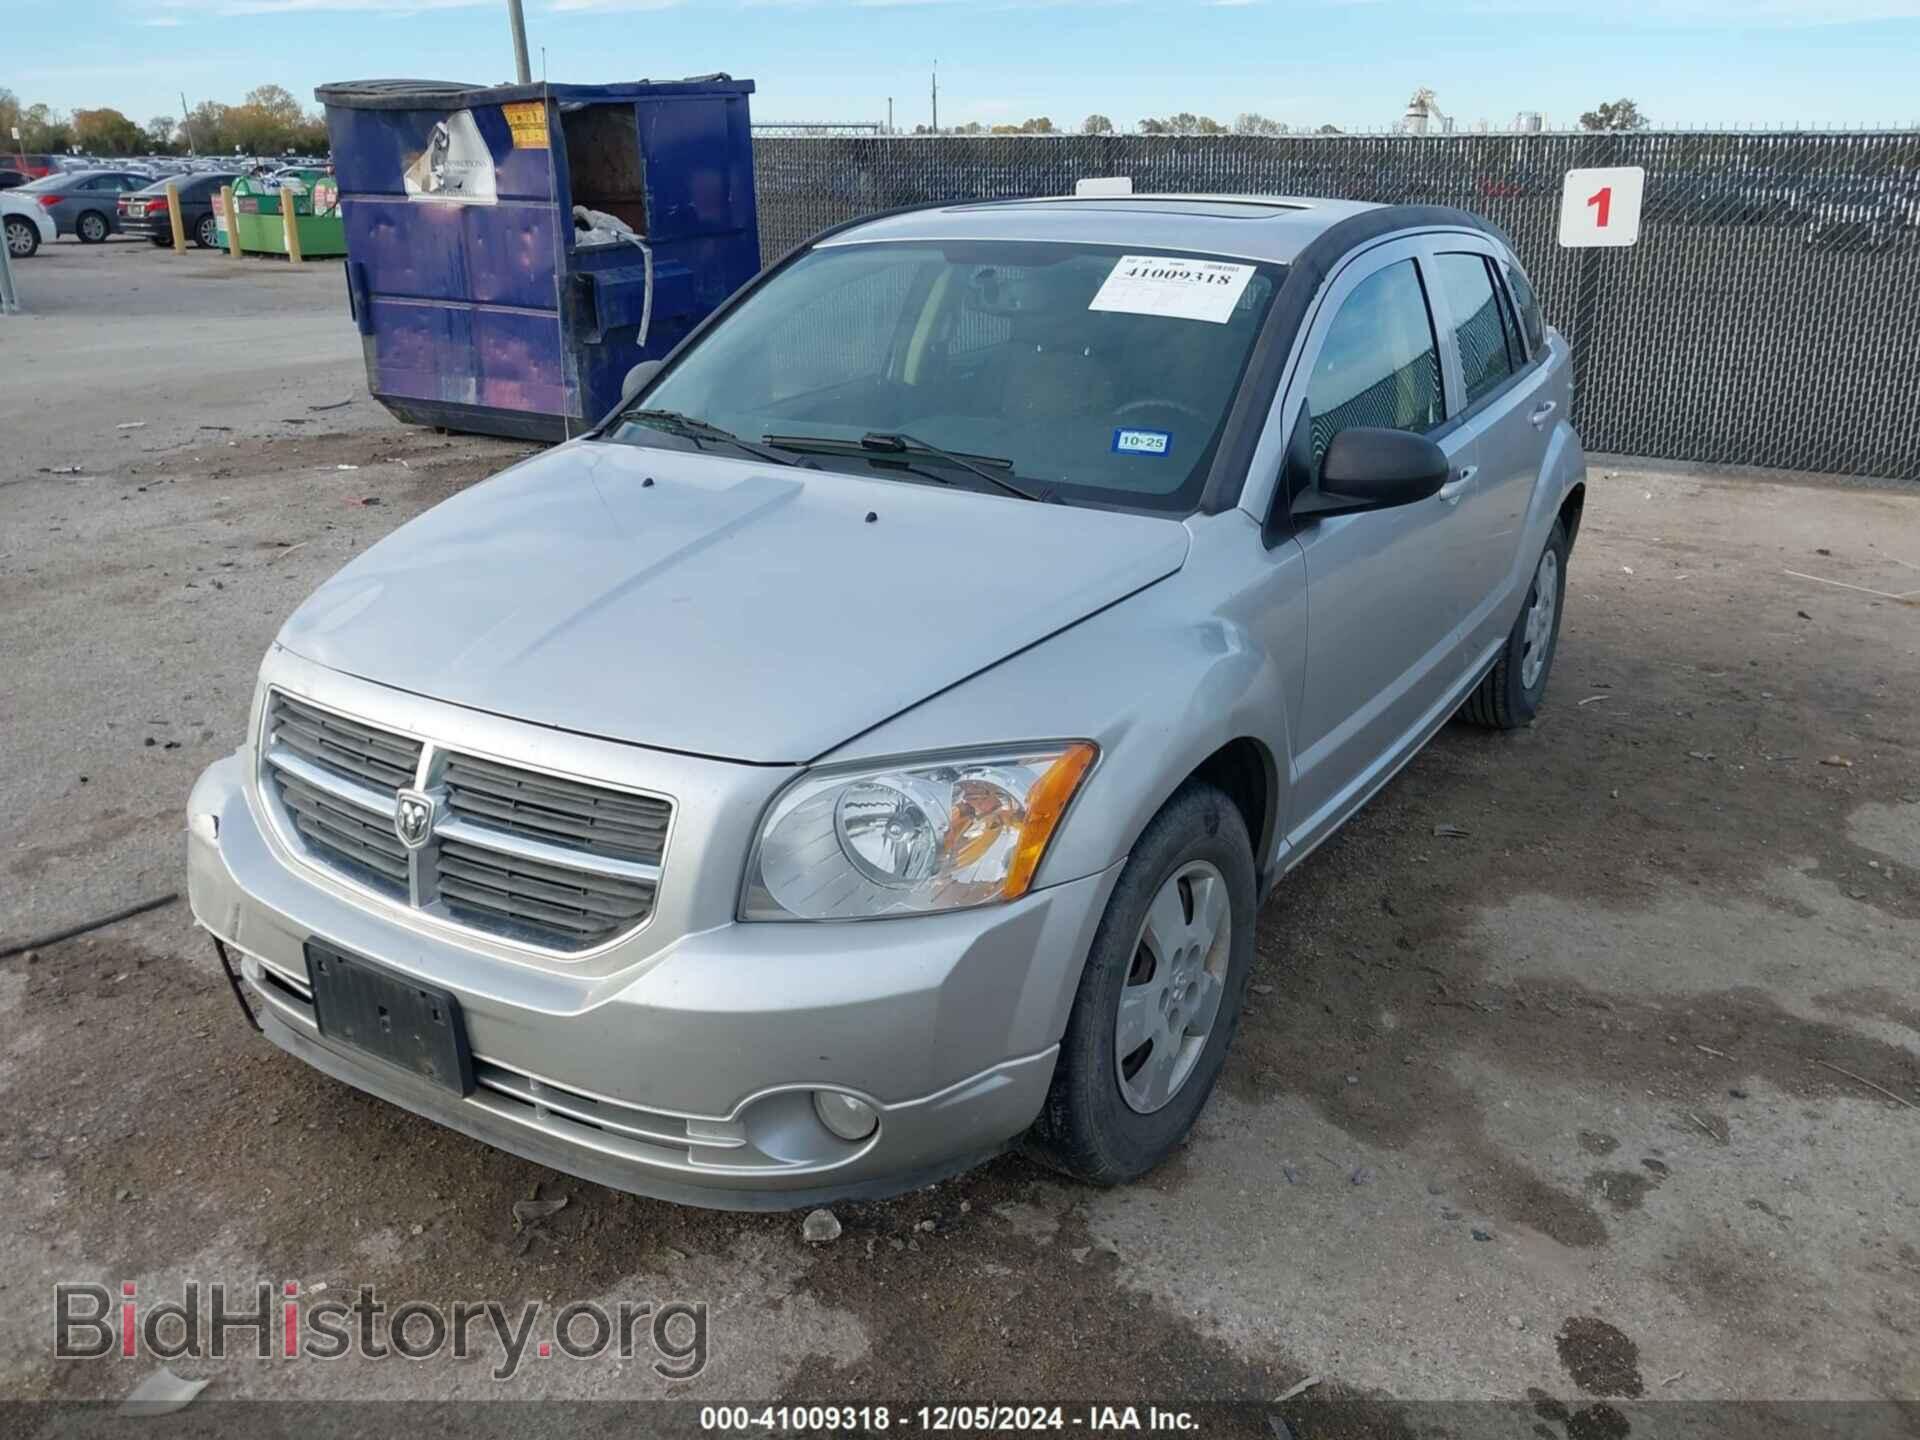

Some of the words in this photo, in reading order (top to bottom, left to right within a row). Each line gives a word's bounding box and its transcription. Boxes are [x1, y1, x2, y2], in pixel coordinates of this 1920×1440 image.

[1587, 187, 1611, 227] 1
[1125, 267, 1232, 285] 41009318
[1123, 435, 1164, 449] 10-25
